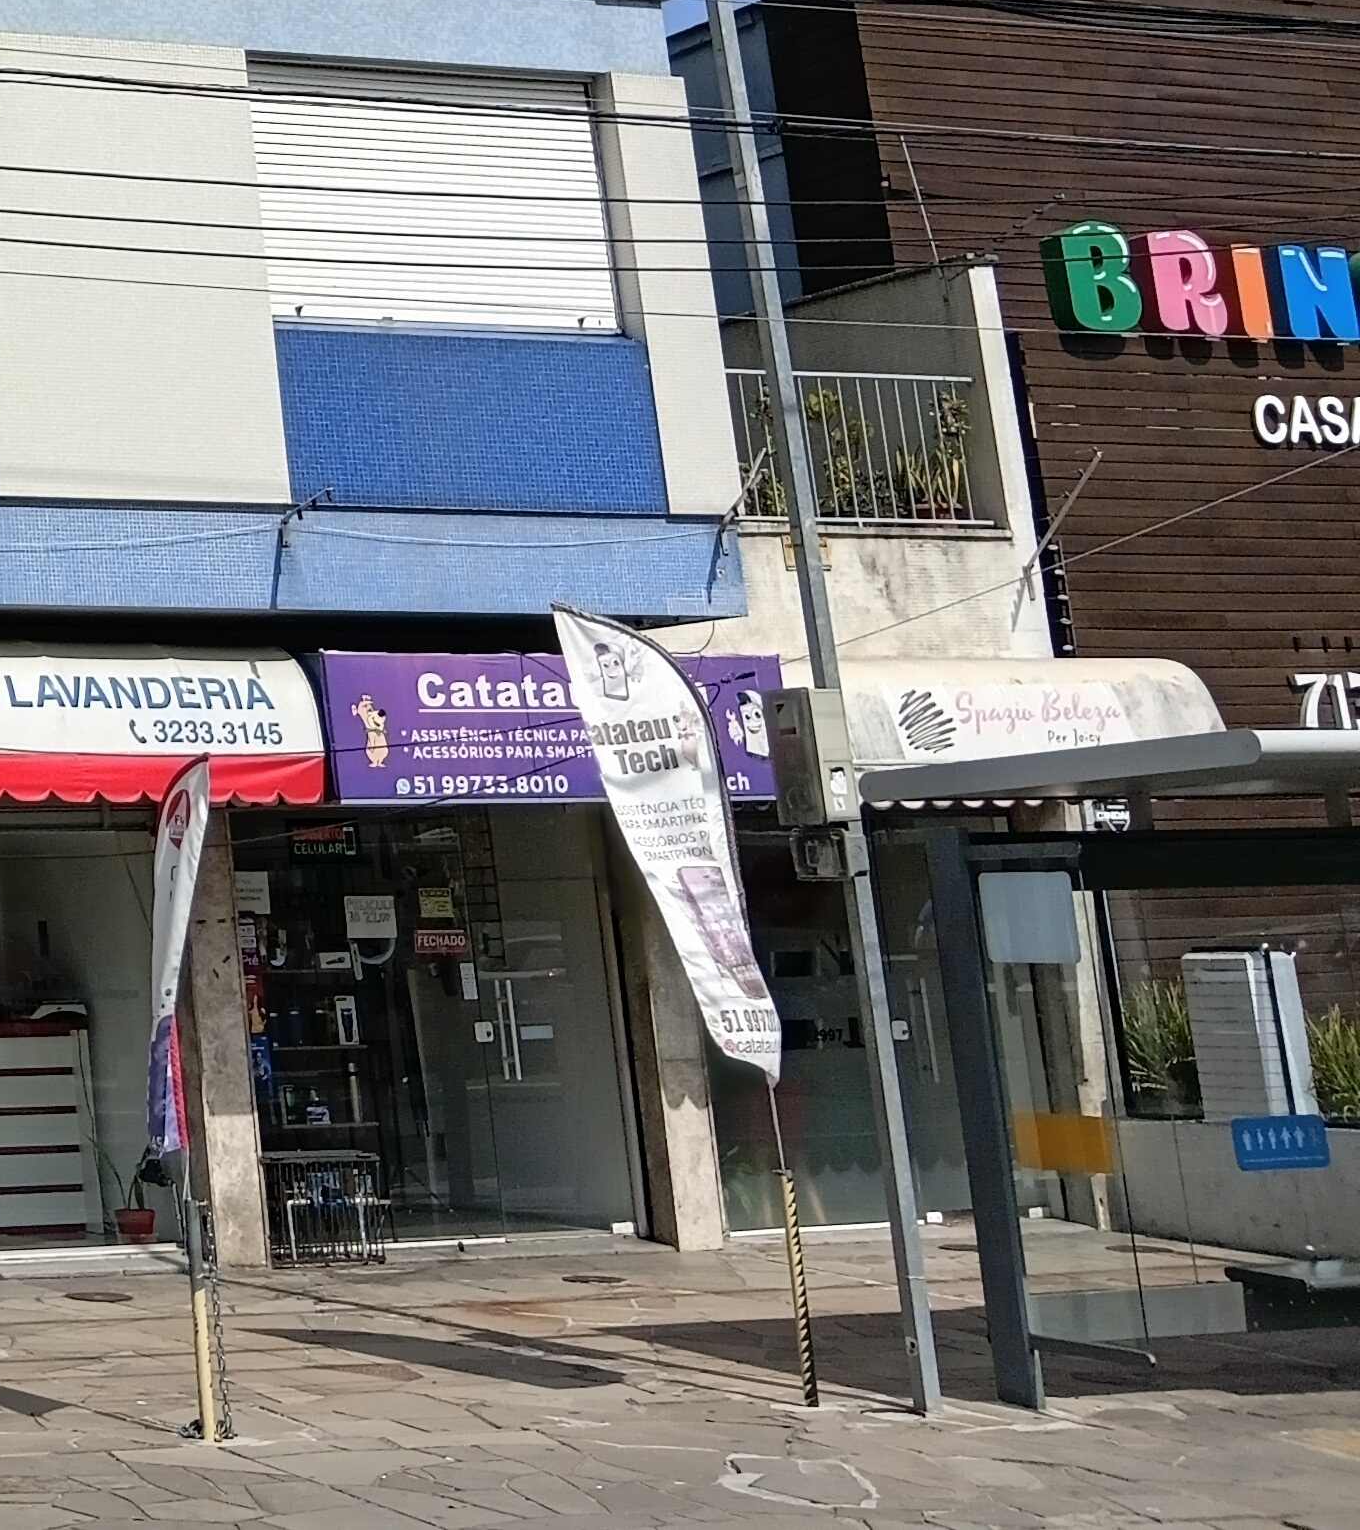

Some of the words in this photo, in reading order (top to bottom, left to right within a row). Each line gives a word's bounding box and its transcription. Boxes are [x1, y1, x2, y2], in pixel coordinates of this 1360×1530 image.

[1048, 220, 1360, 343] BRIN
[1254, 395, 1360, 445] CAS
[4, 673, 275, 711] LAVANDERIA
[1293, 672, 1360, 730] 71
[956, 691, 1035, 735] Spazio
[1041, 689, 1121, 732] Beleza
[153, 719, 283, 745] 3233.3145
[410, 726, 504, 743] ASSISTÊNCIA
[507, 725, 568, 743] TÉCNICA
[591, 717, 672, 746] atatau
[1047, 730, 1068, 744] Per
[412, 743, 503, 759] ACESSÓRIOS
[506, 746, 543, 759] PARA
[546, 746, 593, 759] SMART
[613, 743, 680, 776] Tech
[414, 776, 436, 794] 51
[294, 842, 342, 855] CELULAR
[417, 935, 466, 947] FECHADO
[720, 1010, 744, 1033] 51
